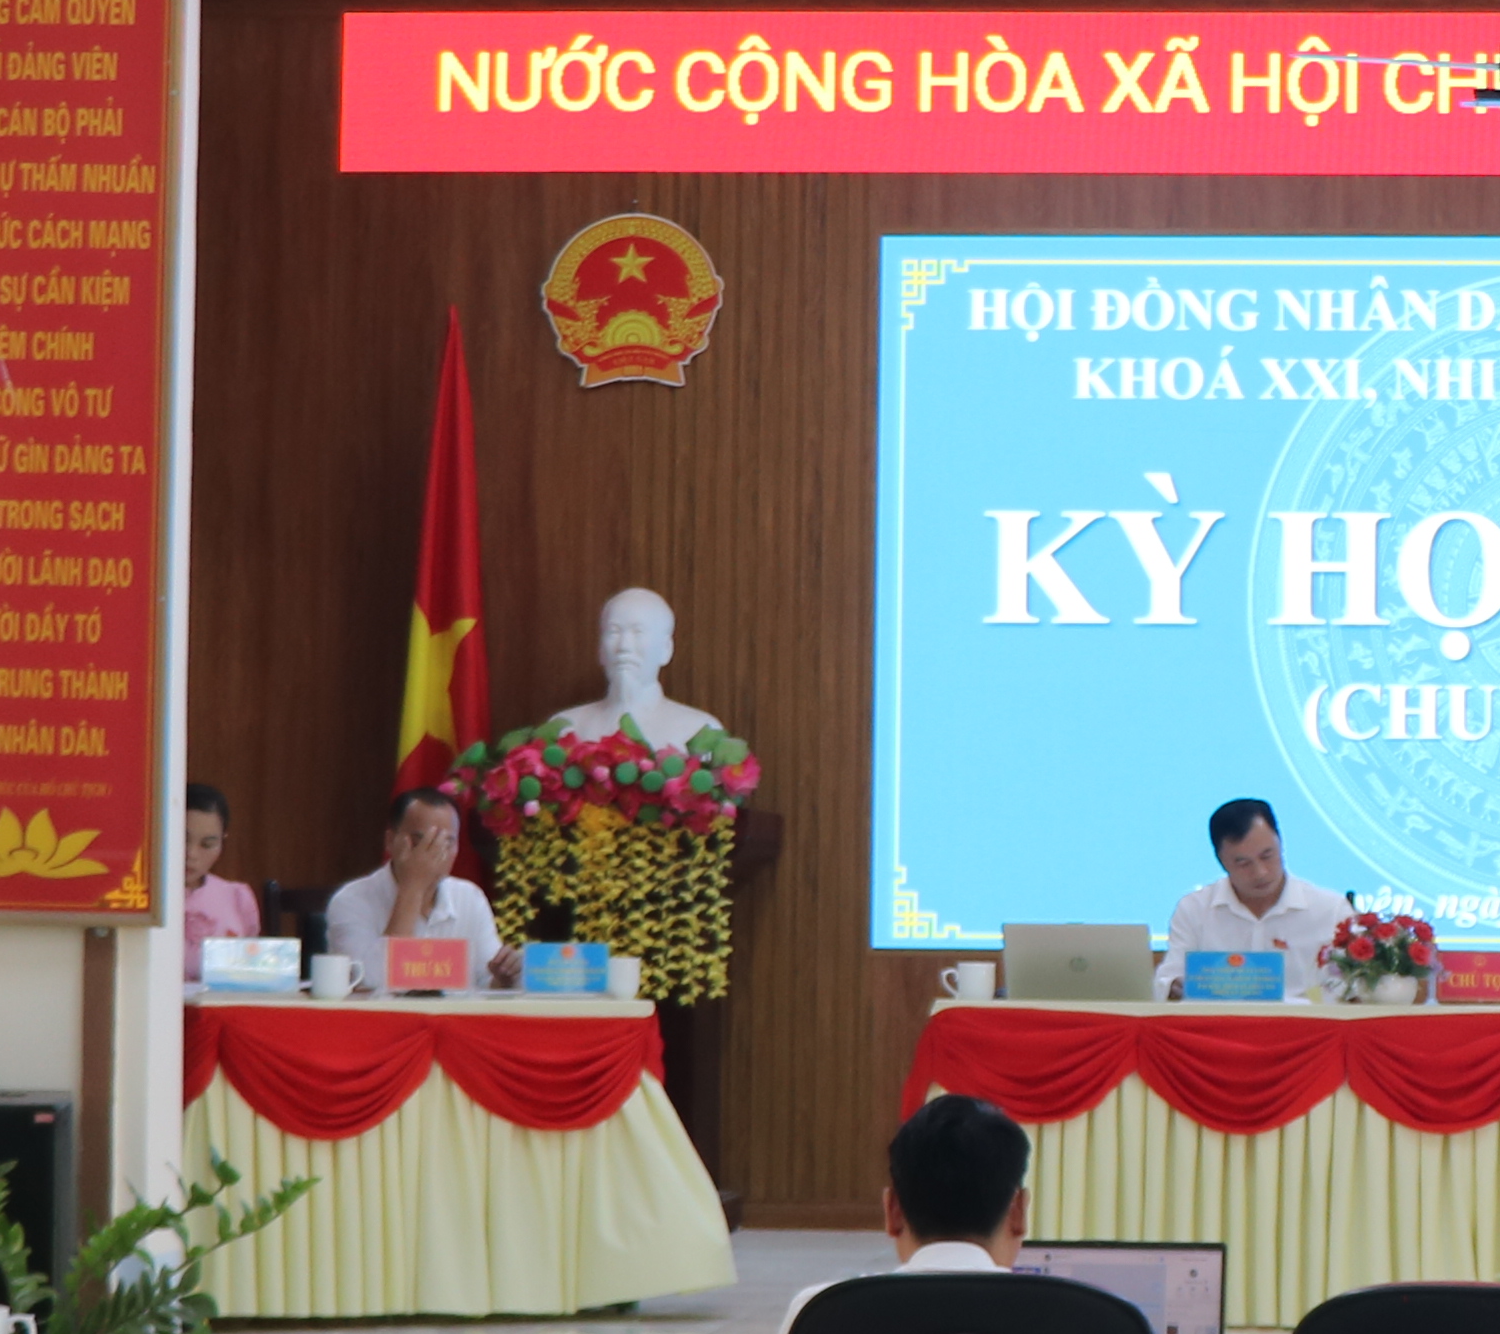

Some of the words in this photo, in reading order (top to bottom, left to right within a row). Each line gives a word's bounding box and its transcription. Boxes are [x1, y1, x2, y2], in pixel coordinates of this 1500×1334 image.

[6, 41, 66, 81] ĐẢNG
[71, 45, 118, 81] VIÊN
[436, 33, 657, 114] NƯỚC
[673, 34, 895, 127] CỘNG
[917, 34, 1086, 114] HÒA
[1100, 35, 1212, 115] XÃ
[1229, 35, 1362, 128] HỘI
[41, 101, 72, 144] BỘ
[74, 96, 124, 137] PHẢI
[26, 212, 84, 250] CÁCH
[88, 219, 152, 257] MẠNG
[79, 269, 131, 312] KIỆM
[966, 281, 1077, 343] HỘI
[1091, 275, 1260, 332] ĐỒNG
[1274, 274, 1440, 332] NHÂN
[31, 326, 94, 361] CHÍNH
[1073, 345, 1245, 401] KHOÁ
[1259, 357, 1379, 408] XXI,
[50, 381, 80, 418] VÔ
[83, 385, 113, 418] TƯ
[12, 435, 50, 474] GÌN
[53, 434, 114, 475] ĐẢNG
[118, 444, 146, 475] TA
[68, 500, 125, 537] SẠCH
[983, 471, 1226, 627] KỲ
[27, 549, 84, 586] LÃNH
[86, 556, 134, 595] ĐẠO
[58, 663, 129, 701] THÀNH
